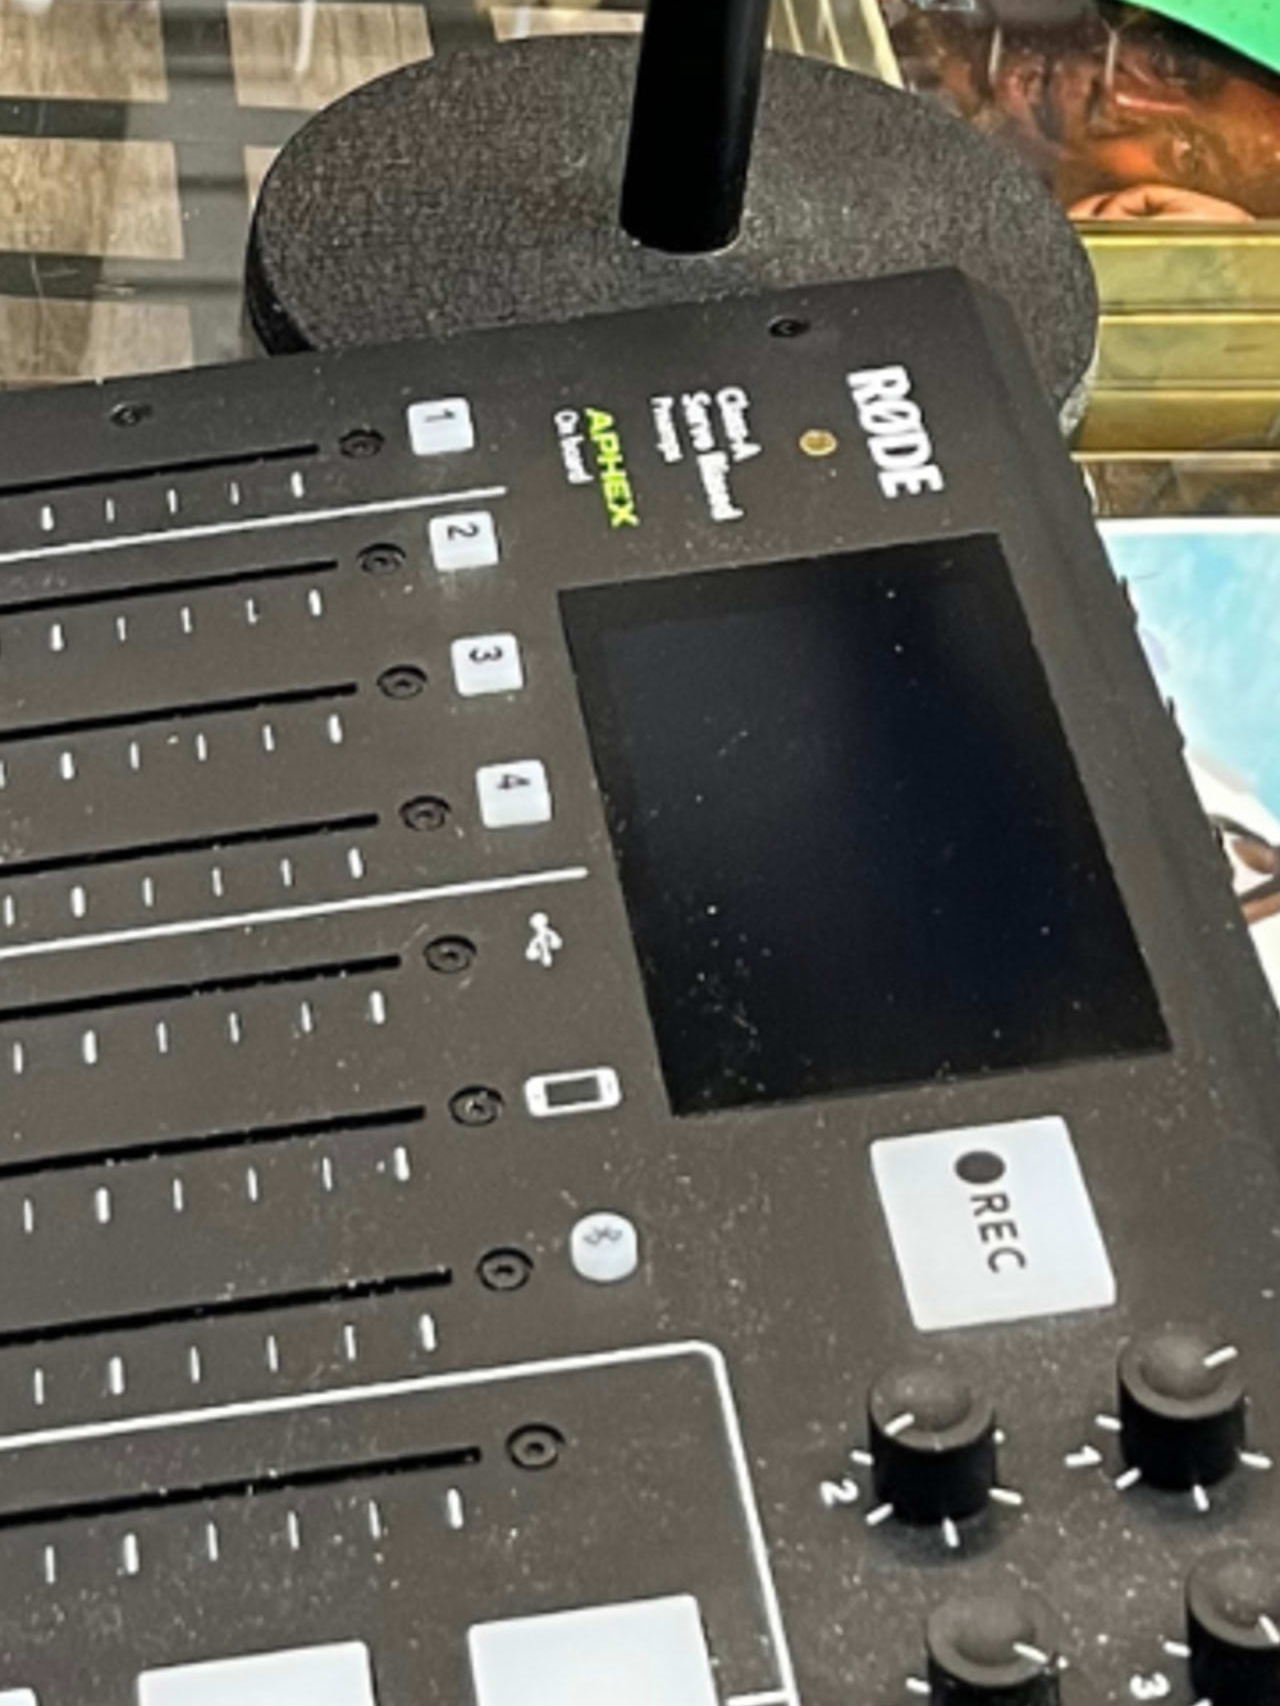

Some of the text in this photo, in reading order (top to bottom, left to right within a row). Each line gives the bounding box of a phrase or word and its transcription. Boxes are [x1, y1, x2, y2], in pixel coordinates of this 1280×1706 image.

[425, 409, 455, 423] 1
[682, 391, 715, 451] Servo
[847, 365, 944, 498] RØDE
[586, 407, 639, 527] APHEX
[447, 521, 479, 539] 2
[469, 646, 503, 663] 3
[497, 773, 531, 791] 4
[970, 1192, 1025, 1273] REC
[1064, 1445, 1102, 1468] 1
[820, 1478, 858, 1506] 2
[1130, 1672, 1170, 1700] 3
